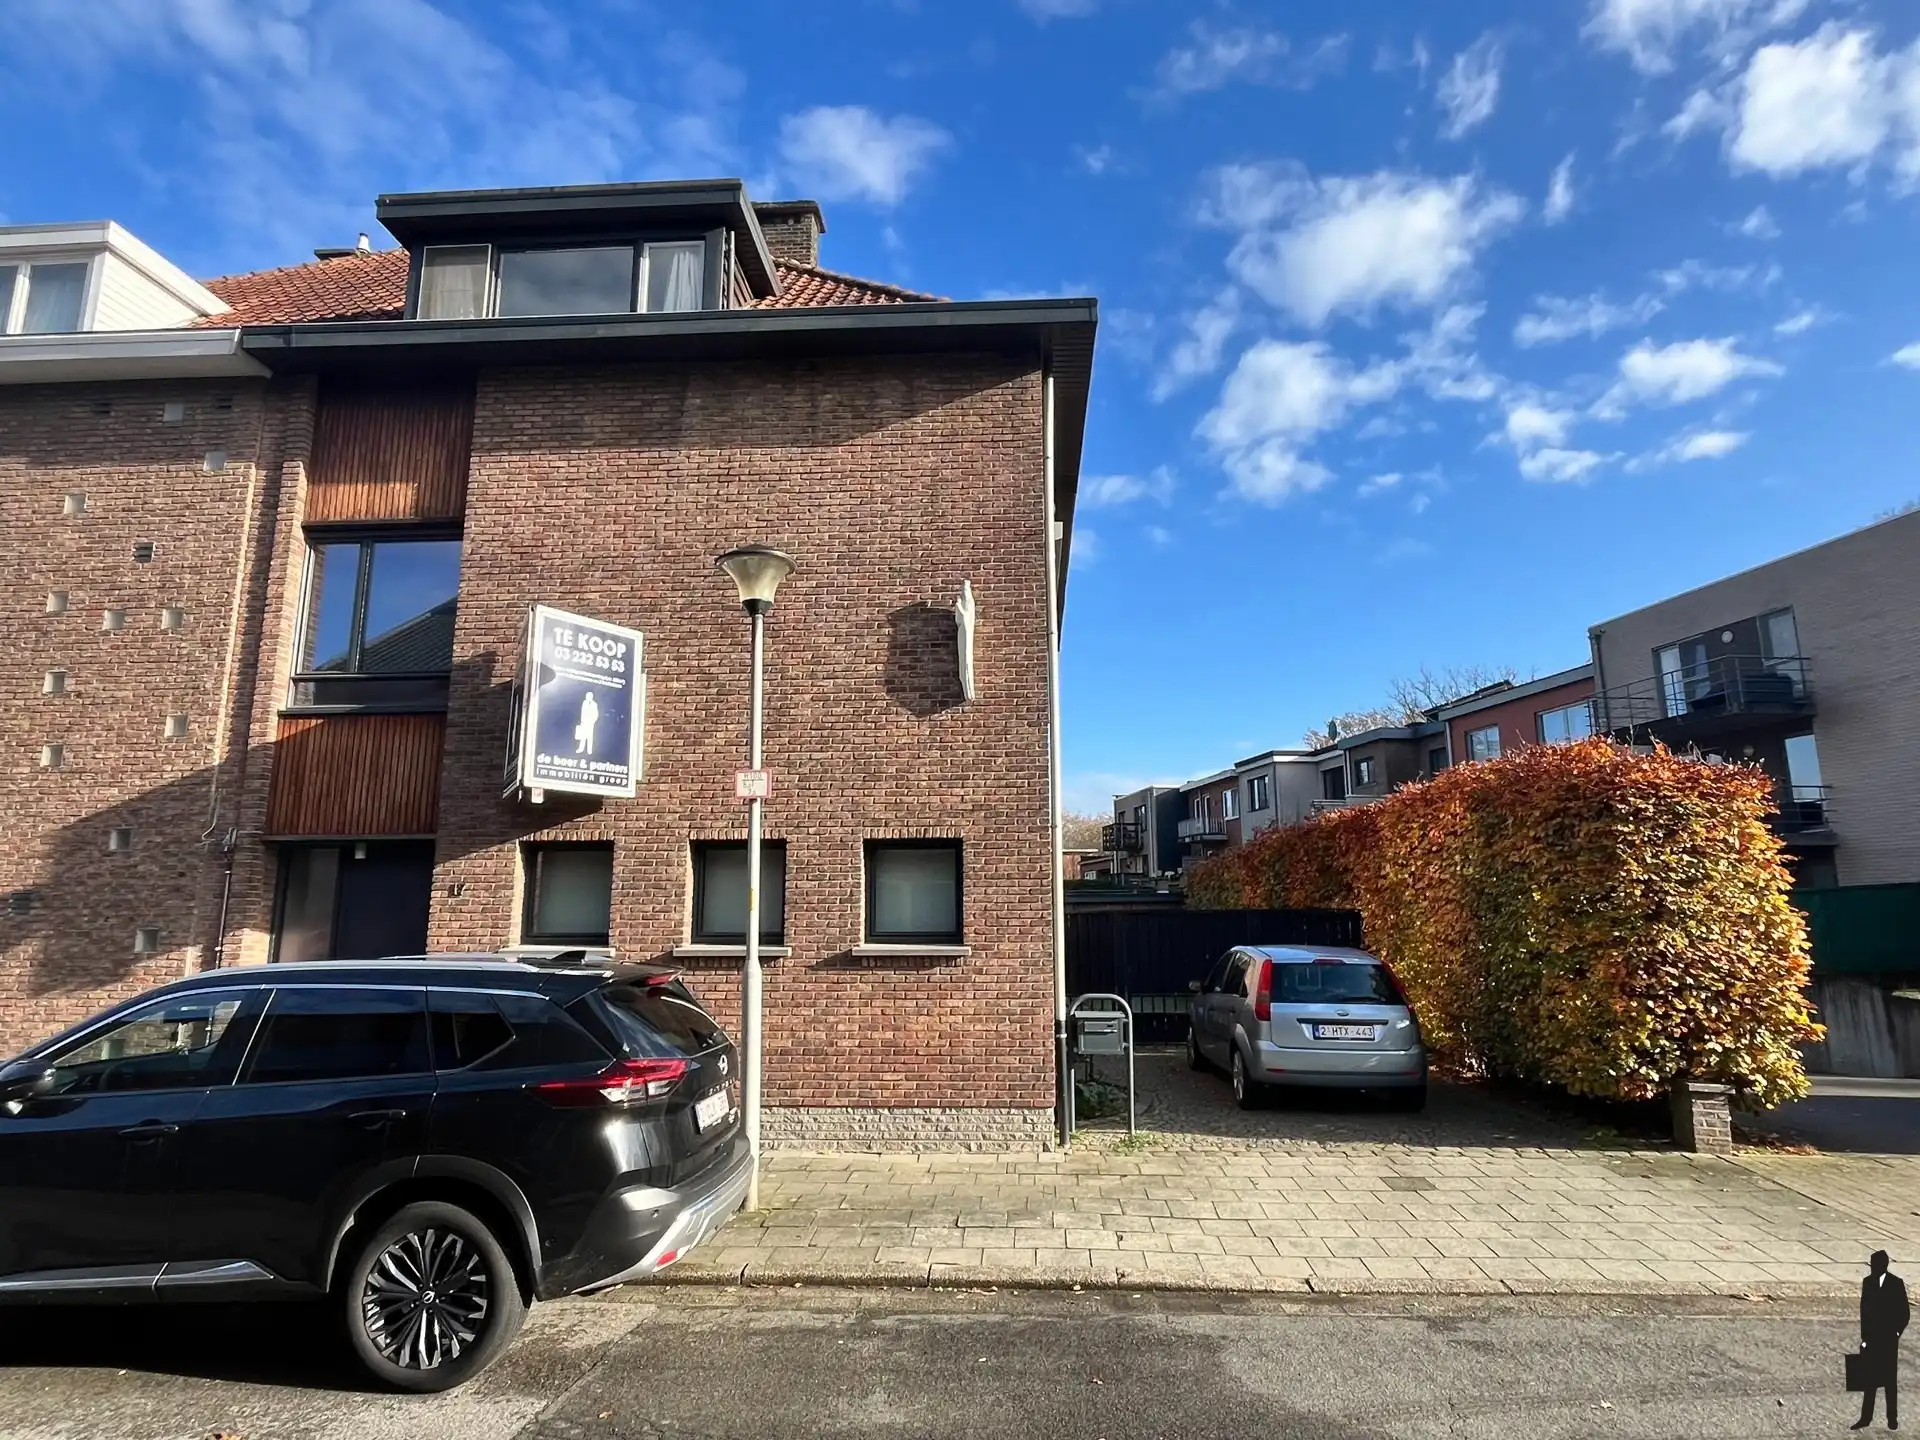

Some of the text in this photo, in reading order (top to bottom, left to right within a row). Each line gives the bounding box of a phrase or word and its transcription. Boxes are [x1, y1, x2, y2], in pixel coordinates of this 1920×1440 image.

[553, 627, 626, 658] TE KOOP
[572, 650, 593, 666] 232
[537, 753, 551, 764] de
[580, 759, 588, 769] &
[590, 761, 628, 774] partners
[599, 775, 628, 786] groep
